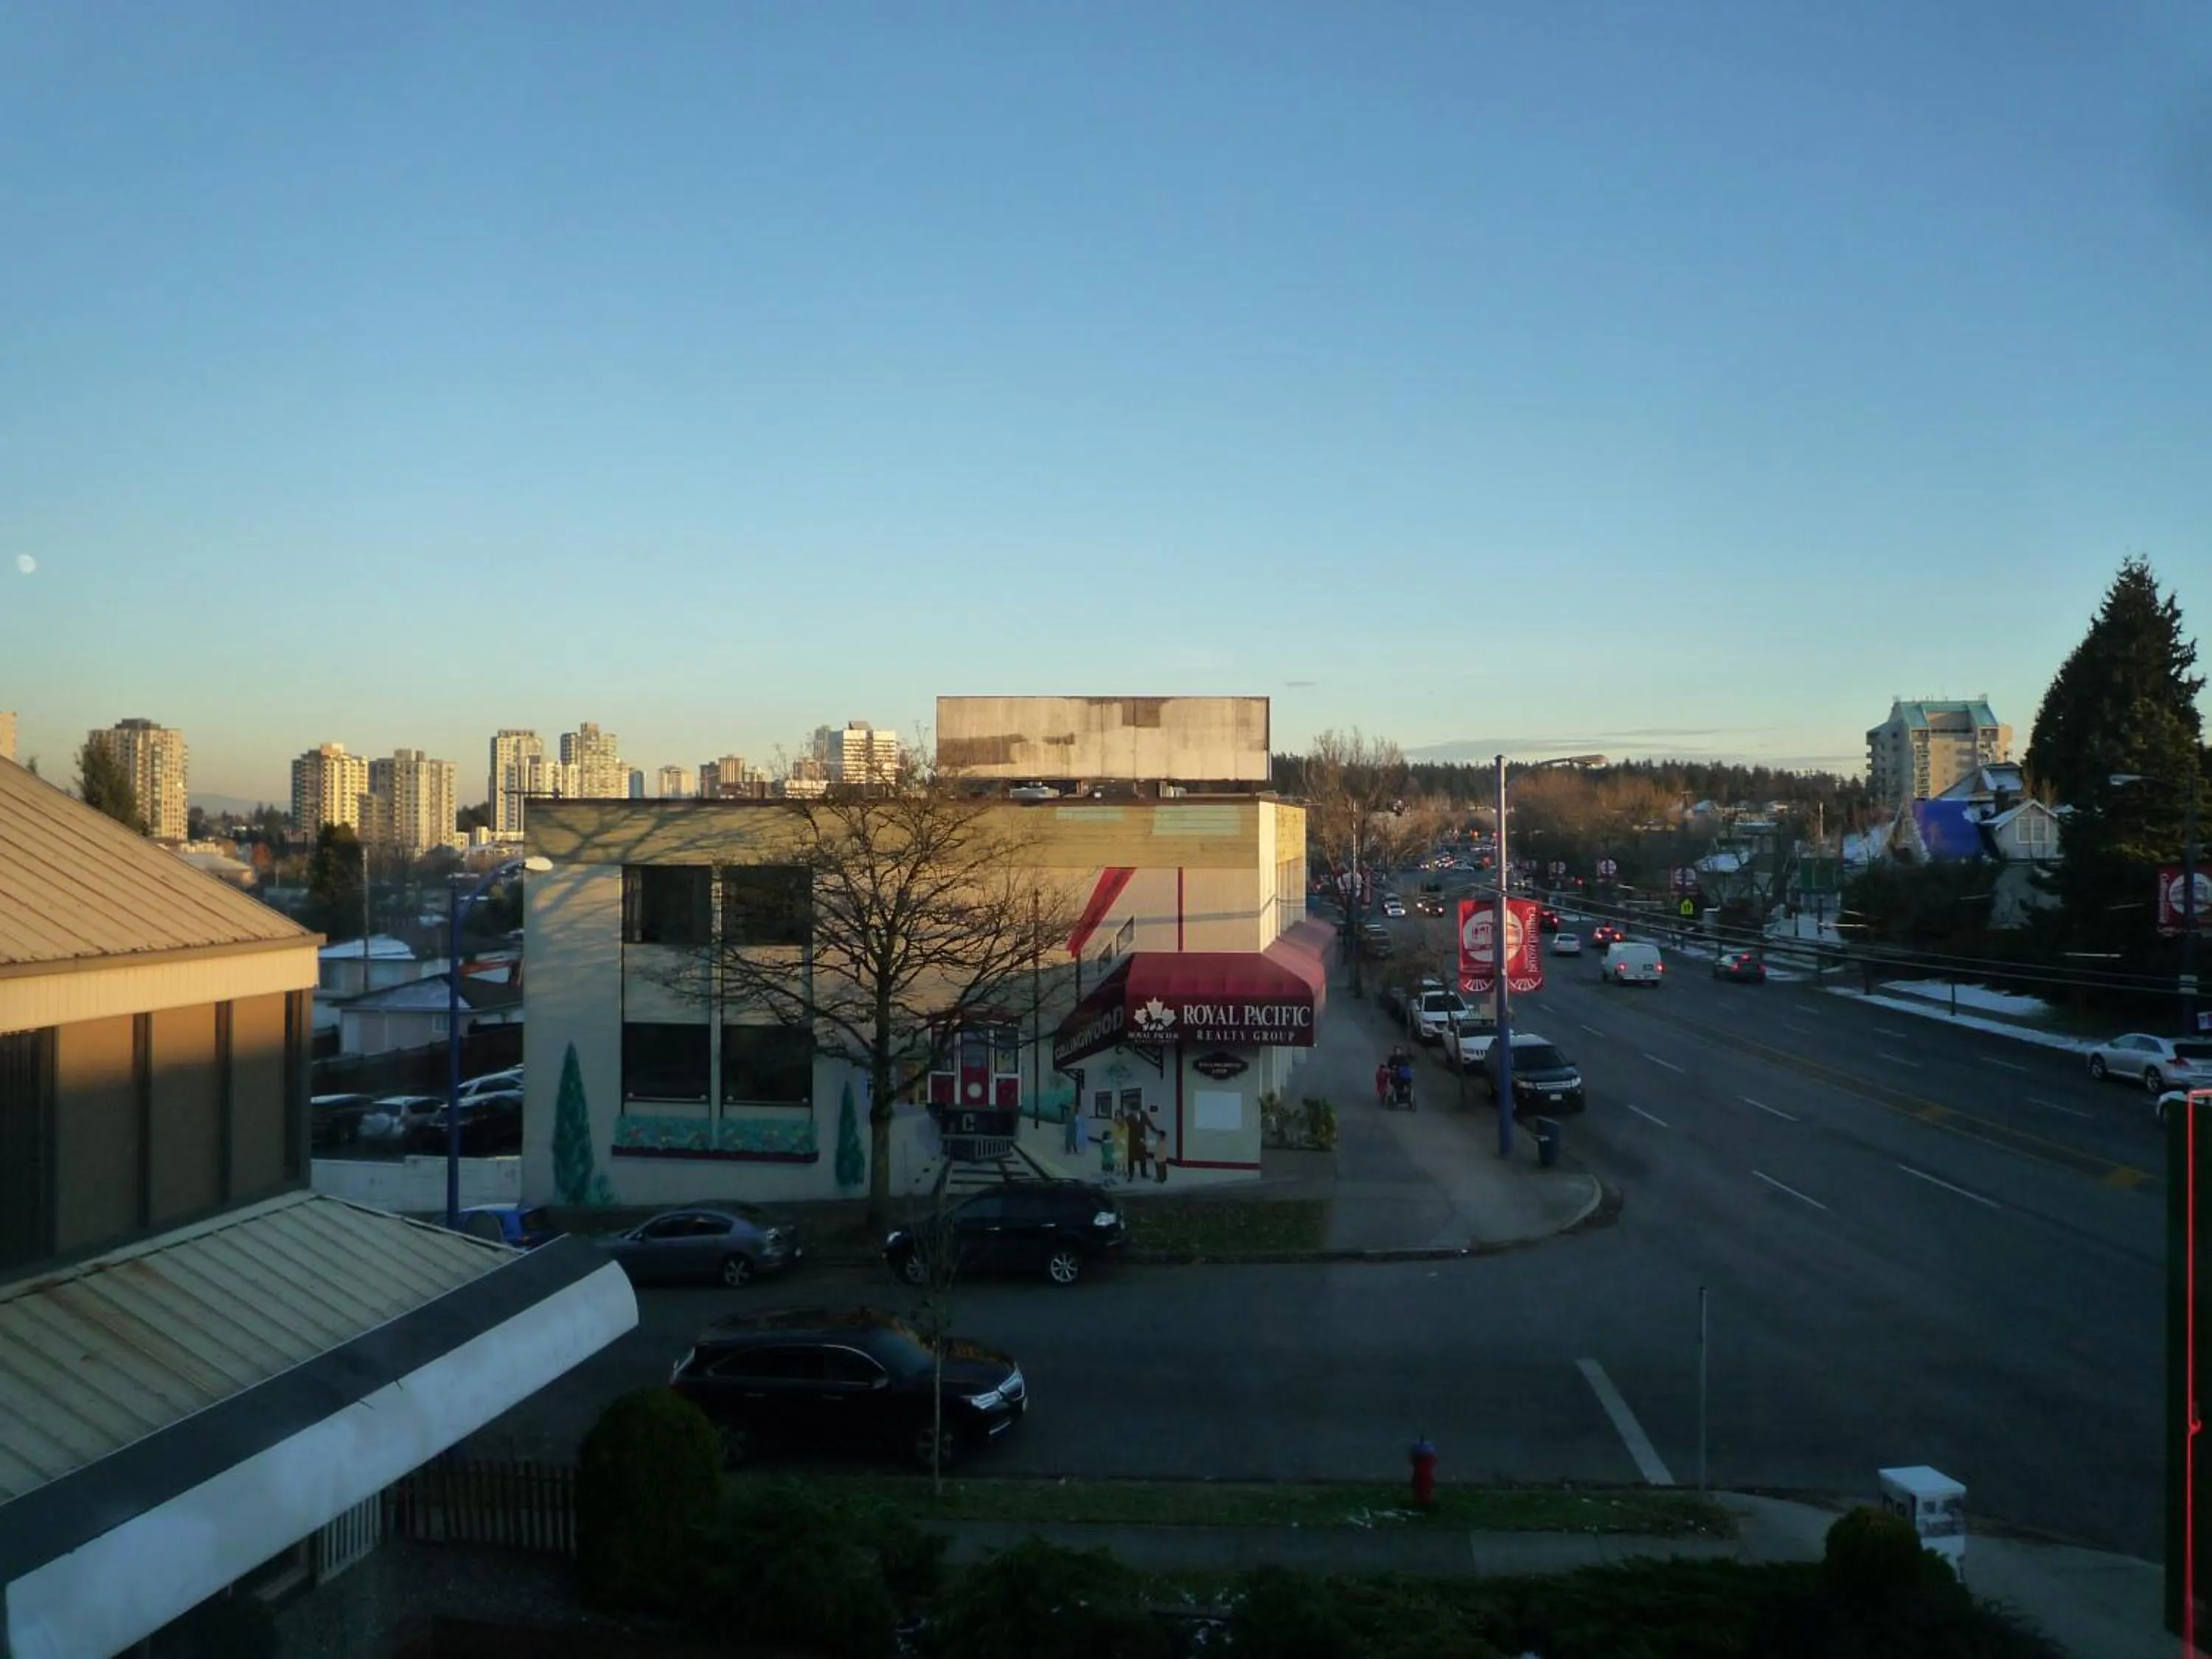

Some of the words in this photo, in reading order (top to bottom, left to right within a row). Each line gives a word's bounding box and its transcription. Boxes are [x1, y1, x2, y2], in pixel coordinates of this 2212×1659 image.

[1183, 1004, 1239, 1026] ROYAL
[1244, 1004, 1310, 1027] PACIFIC
[1054, 1005, 1124, 1060] COLLINGWOOD
[1197, 1029, 1246, 1041] REALTY
[1253, 1030, 1296, 1042] GROUP
